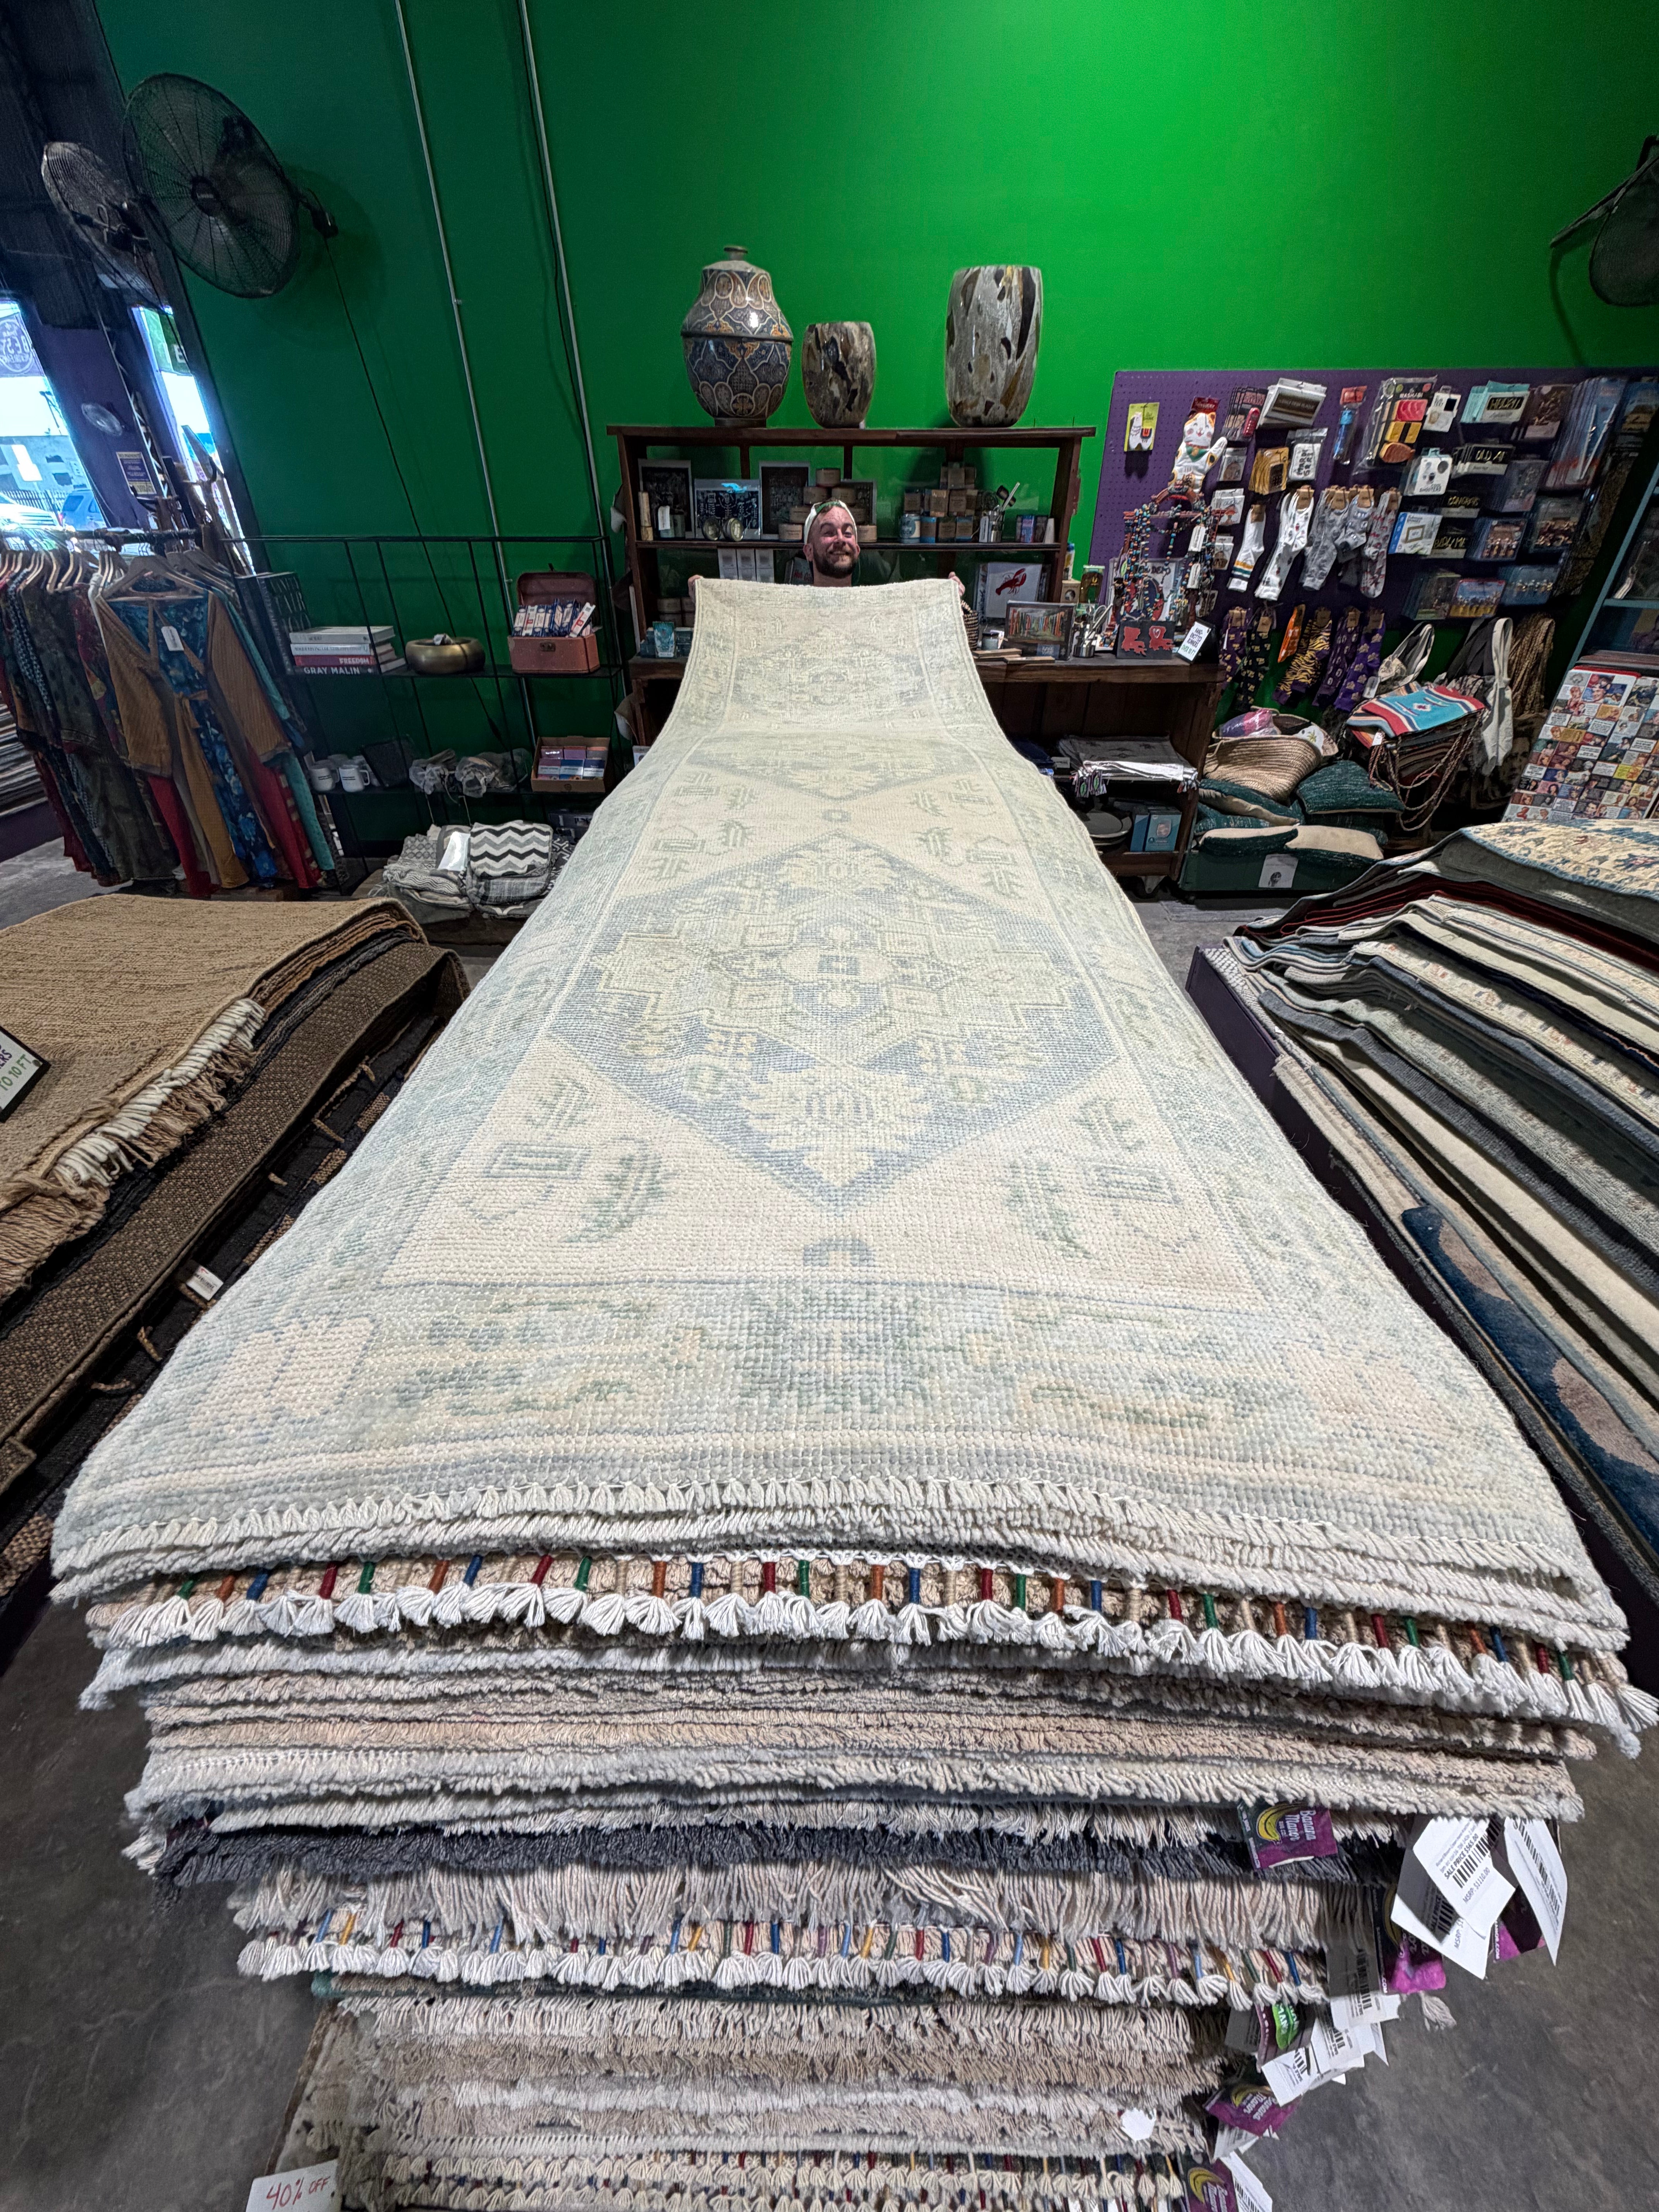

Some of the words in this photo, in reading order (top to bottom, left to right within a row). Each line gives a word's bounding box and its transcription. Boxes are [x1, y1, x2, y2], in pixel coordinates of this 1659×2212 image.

[9, 1066, 22, 1078] 10
[16, 1054, 31, 1070] FT
[1285, 1814, 1300, 1841] Manor
[1300, 1810, 1316, 1841] Banana
[1444, 1865, 1455, 1880] SALE
[1453, 1851, 1466, 1867] PRICE
[1464, 1833, 1479, 1854] $565.00
[1463, 1887, 1477, 1903] MSRP:
[1474, 1867, 1490, 1890] $1110.00
[1243, 2092, 1267, 2114] Manor
[266, 2177, 304, 2210] 40%
[309, 2176, 331, 2195] OFF
